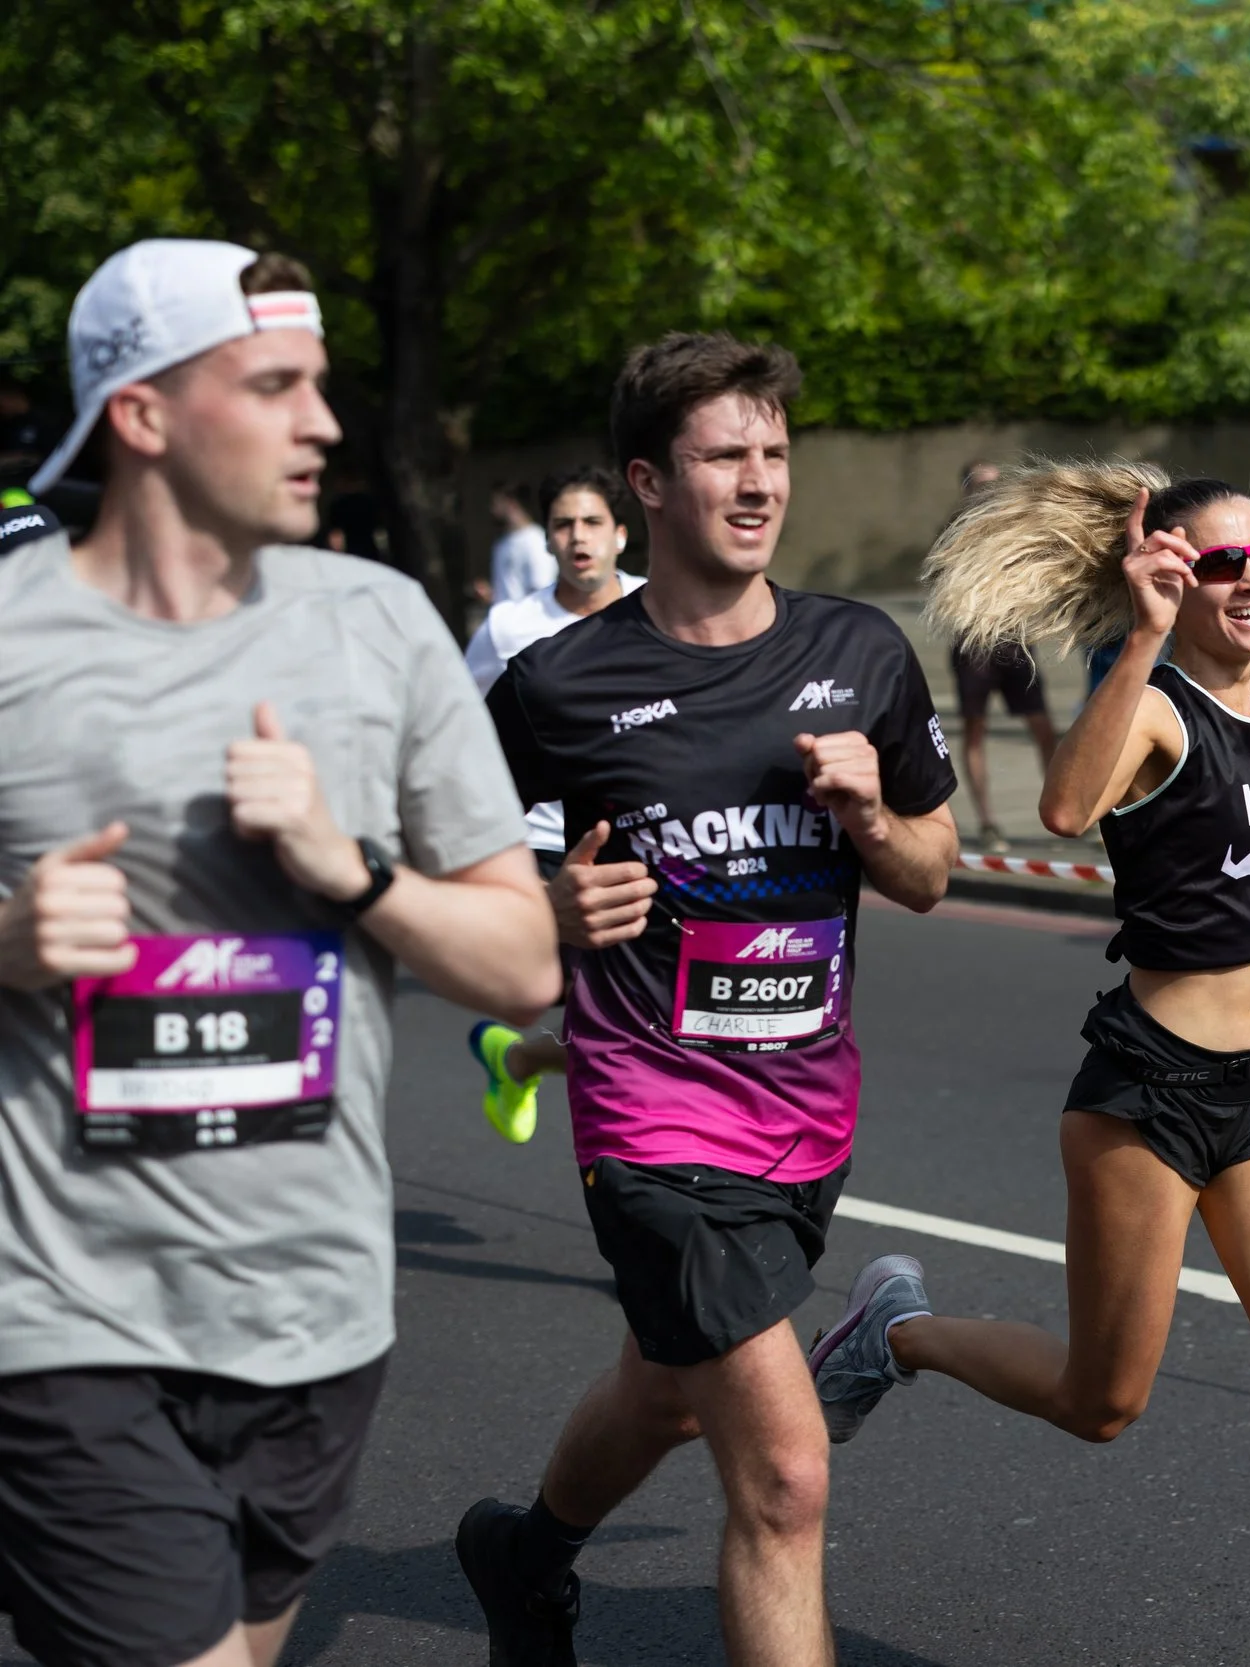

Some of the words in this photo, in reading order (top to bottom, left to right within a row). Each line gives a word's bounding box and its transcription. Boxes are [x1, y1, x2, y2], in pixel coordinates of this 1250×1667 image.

[610, 698, 678, 733] HOKA
[643, 802, 668, 821] GO
[627, 804, 844, 865] HACKNEY
[726, 856, 768, 877] 2024
[710, 975, 733, 1000] B
[738, 975, 813, 1001] 2607
[154, 1012, 190, 1054] B
[195, 1011, 249, 1052] 18
[693, 1014, 783, 1035] CHARLIE
